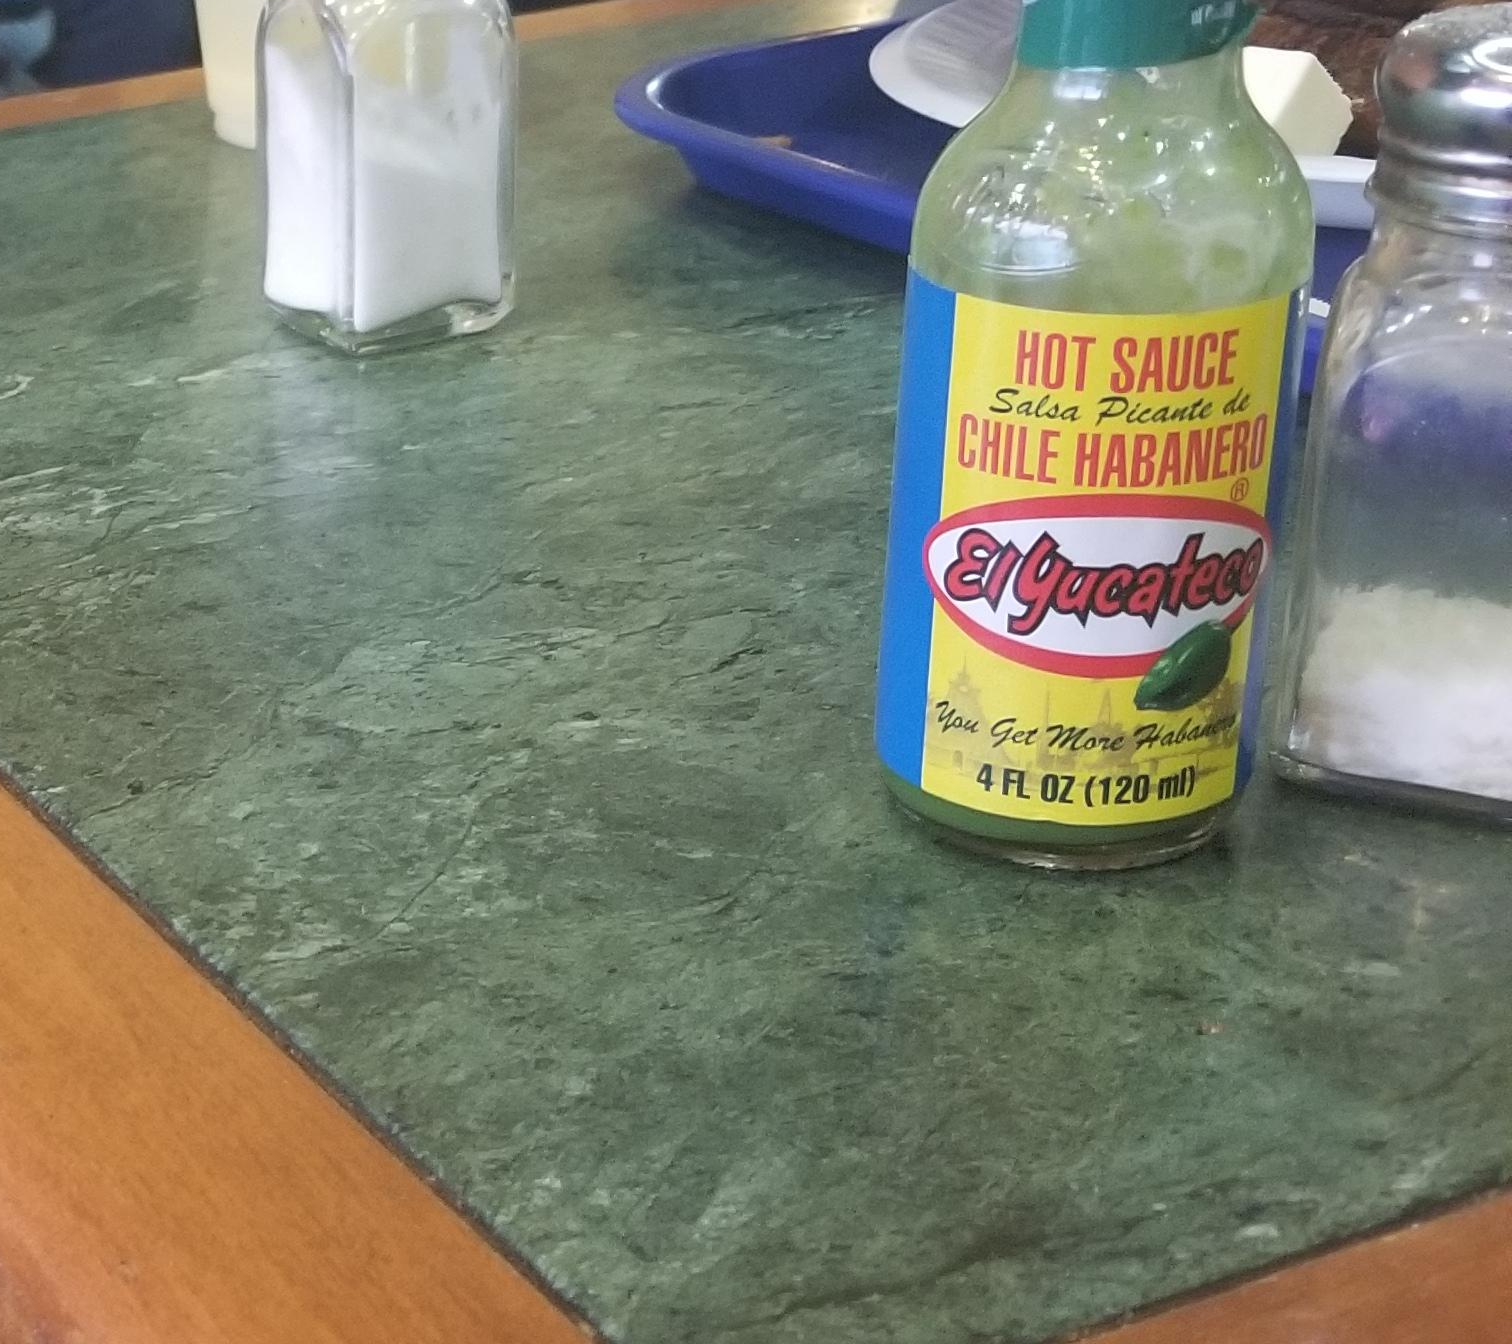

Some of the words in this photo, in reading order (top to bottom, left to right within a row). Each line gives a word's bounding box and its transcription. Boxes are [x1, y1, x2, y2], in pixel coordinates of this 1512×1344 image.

[1015, 329, 1096, 392] HOT
[1110, 328, 1240, 394] SAUCE
[989, 387, 1081, 422] Salsa
[1095, 395, 1214, 426] Picante
[1222, 387, 1251, 414] de
[957, 413, 1061, 485] CHILE
[1073, 412, 1268, 488] HABANERO
[944, 528, 1023, 613] El
[1007, 530, 1264, 636] Yucateco
[935, 700, 981, 734] You
[990, 717, 1039, 748] Get
[1045, 723, 1127, 752] More
[976, 762, 993, 792] 4
[1001, 767, 1031, 800] FL
[1040, 773, 1078, 805] OZ
[1083, 772, 1151, 808] (120
[1157, 765, 1197, 802] ml)
